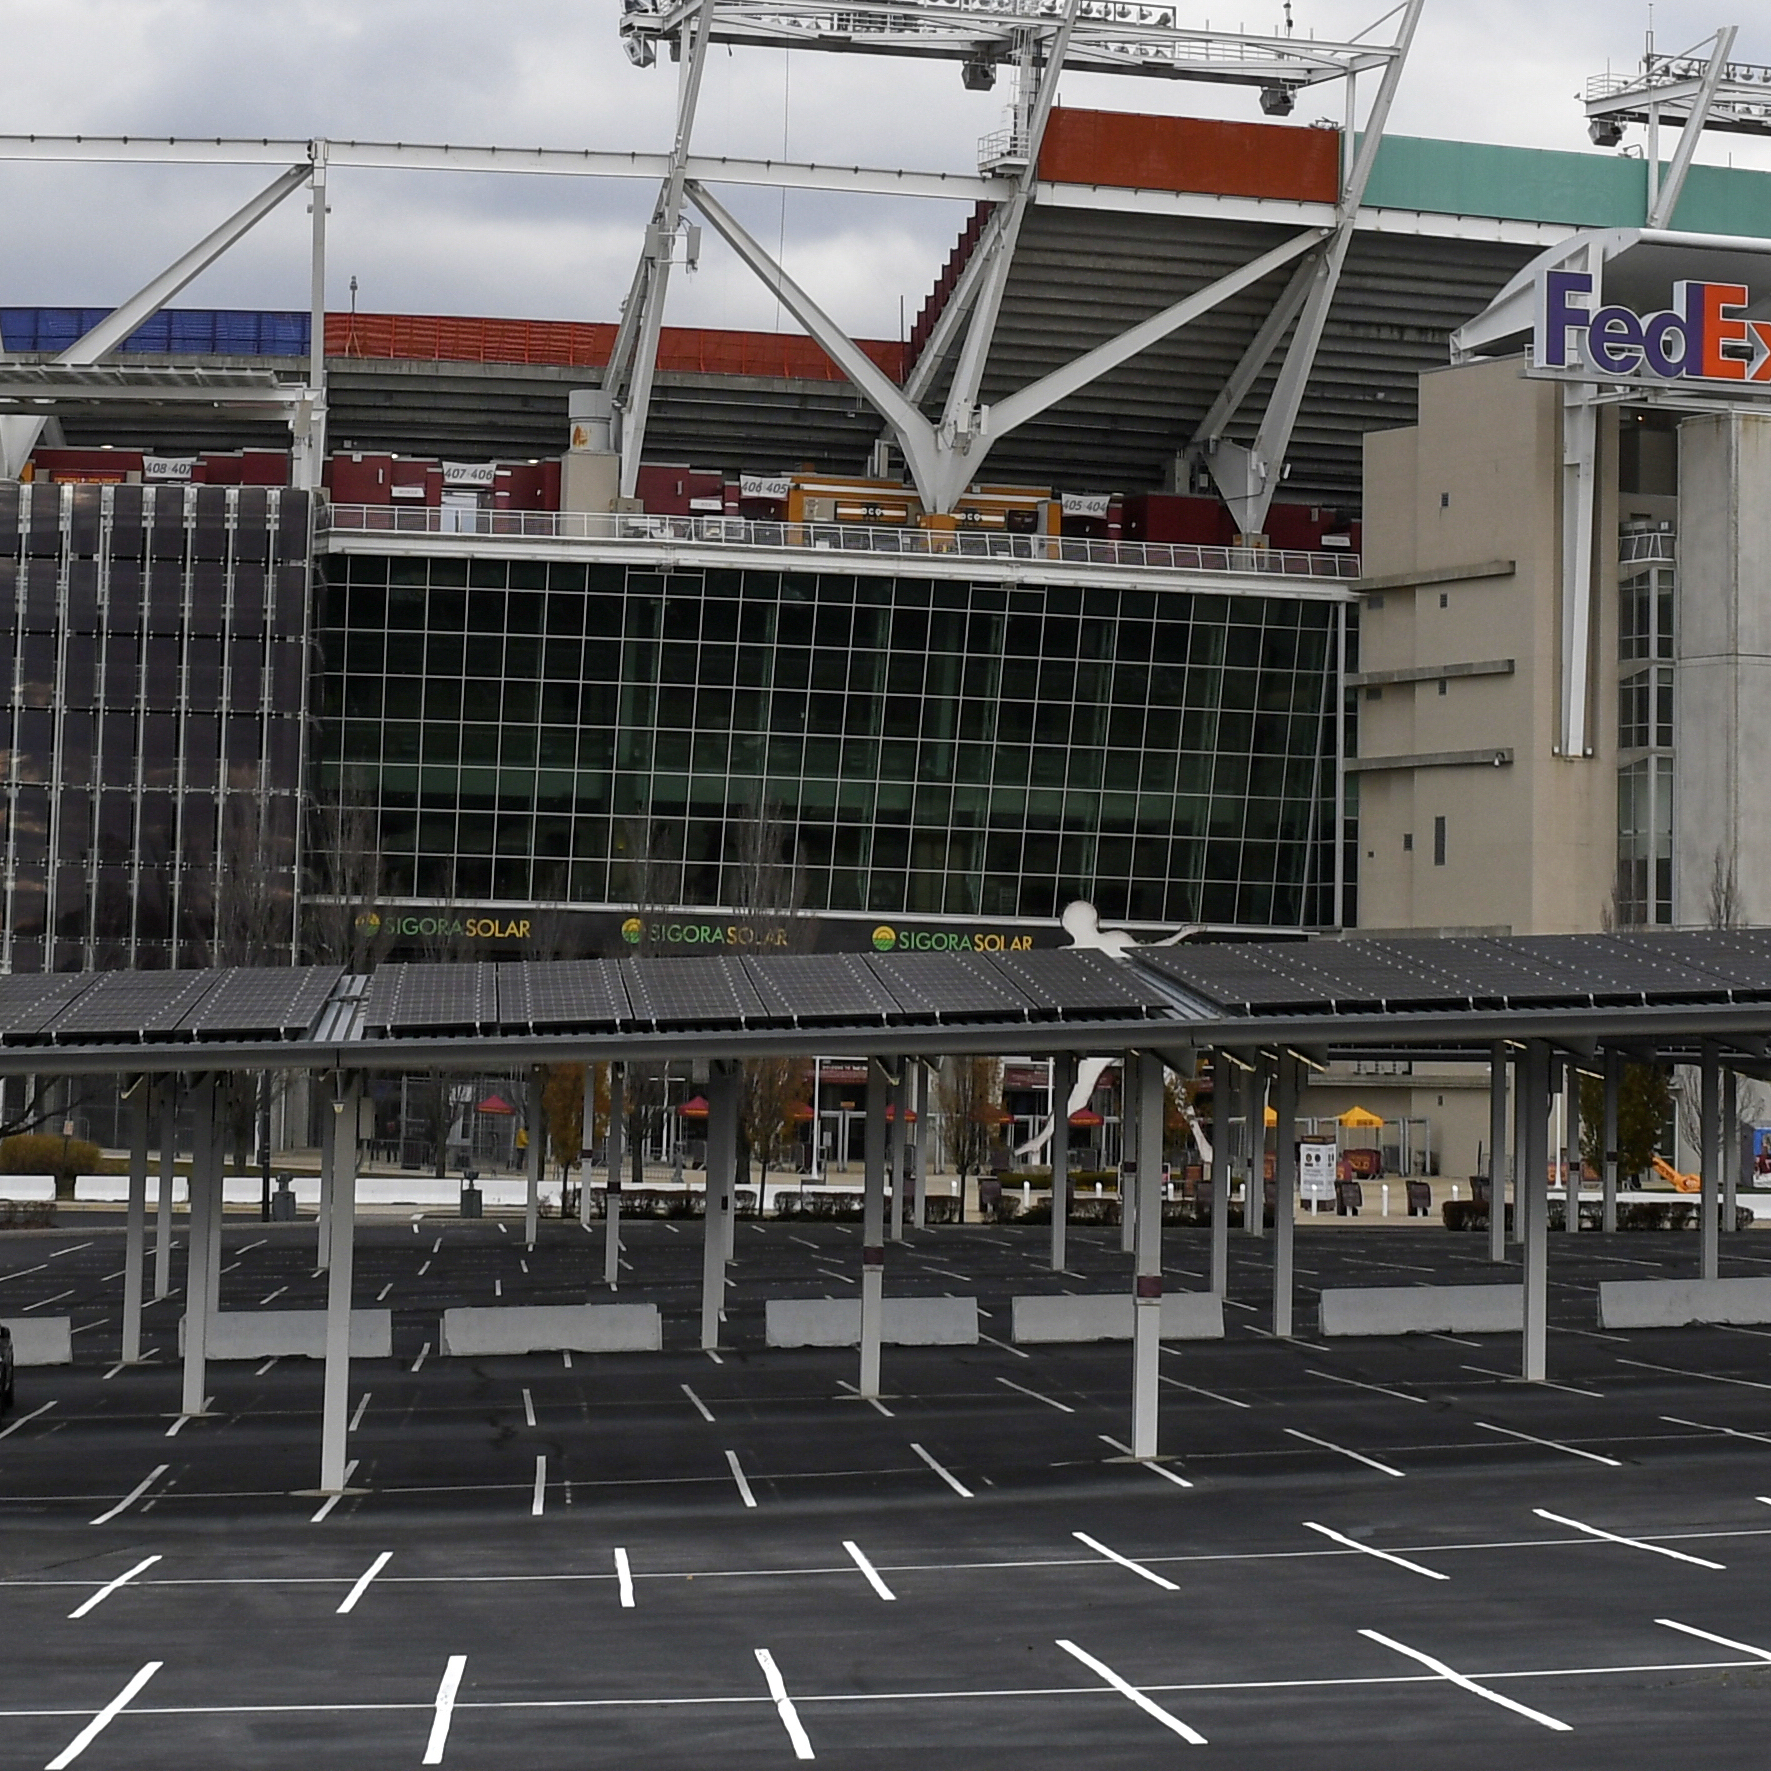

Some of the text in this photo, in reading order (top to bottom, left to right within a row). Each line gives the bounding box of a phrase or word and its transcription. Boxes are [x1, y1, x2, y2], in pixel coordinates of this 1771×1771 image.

[145, 462, 192, 475] 408 407
[445, 468, 494, 480] 407 406
[742, 481, 788, 494] 406 405
[1063, 499, 1106, 512] 405 404
